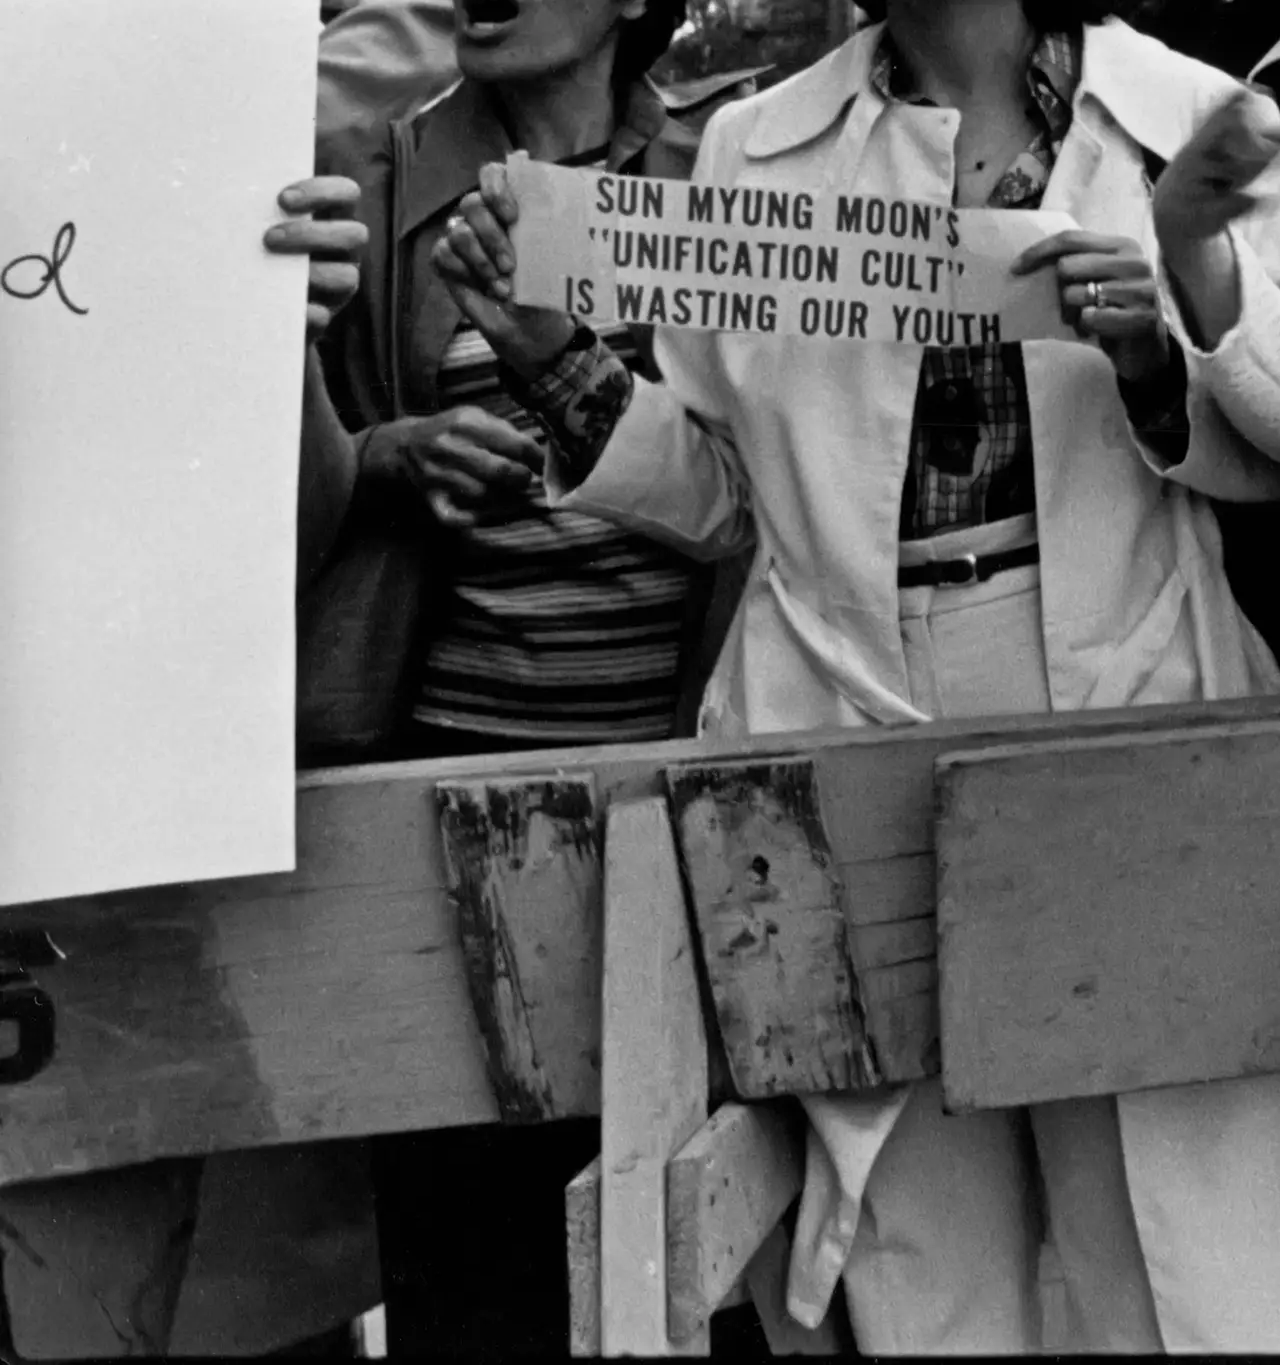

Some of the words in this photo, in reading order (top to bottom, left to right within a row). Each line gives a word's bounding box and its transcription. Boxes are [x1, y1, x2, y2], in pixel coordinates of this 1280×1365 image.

[596, 176, 664, 219] SUN
[688, 186, 813, 230] MYUNG
[836, 196, 960, 248] MOON'S
[565, 277, 595, 315] IS
[616, 284, 778, 332] WASTING
[800, 298, 868, 338] OUR
[892, 305, 1000, 347] YOUTH
